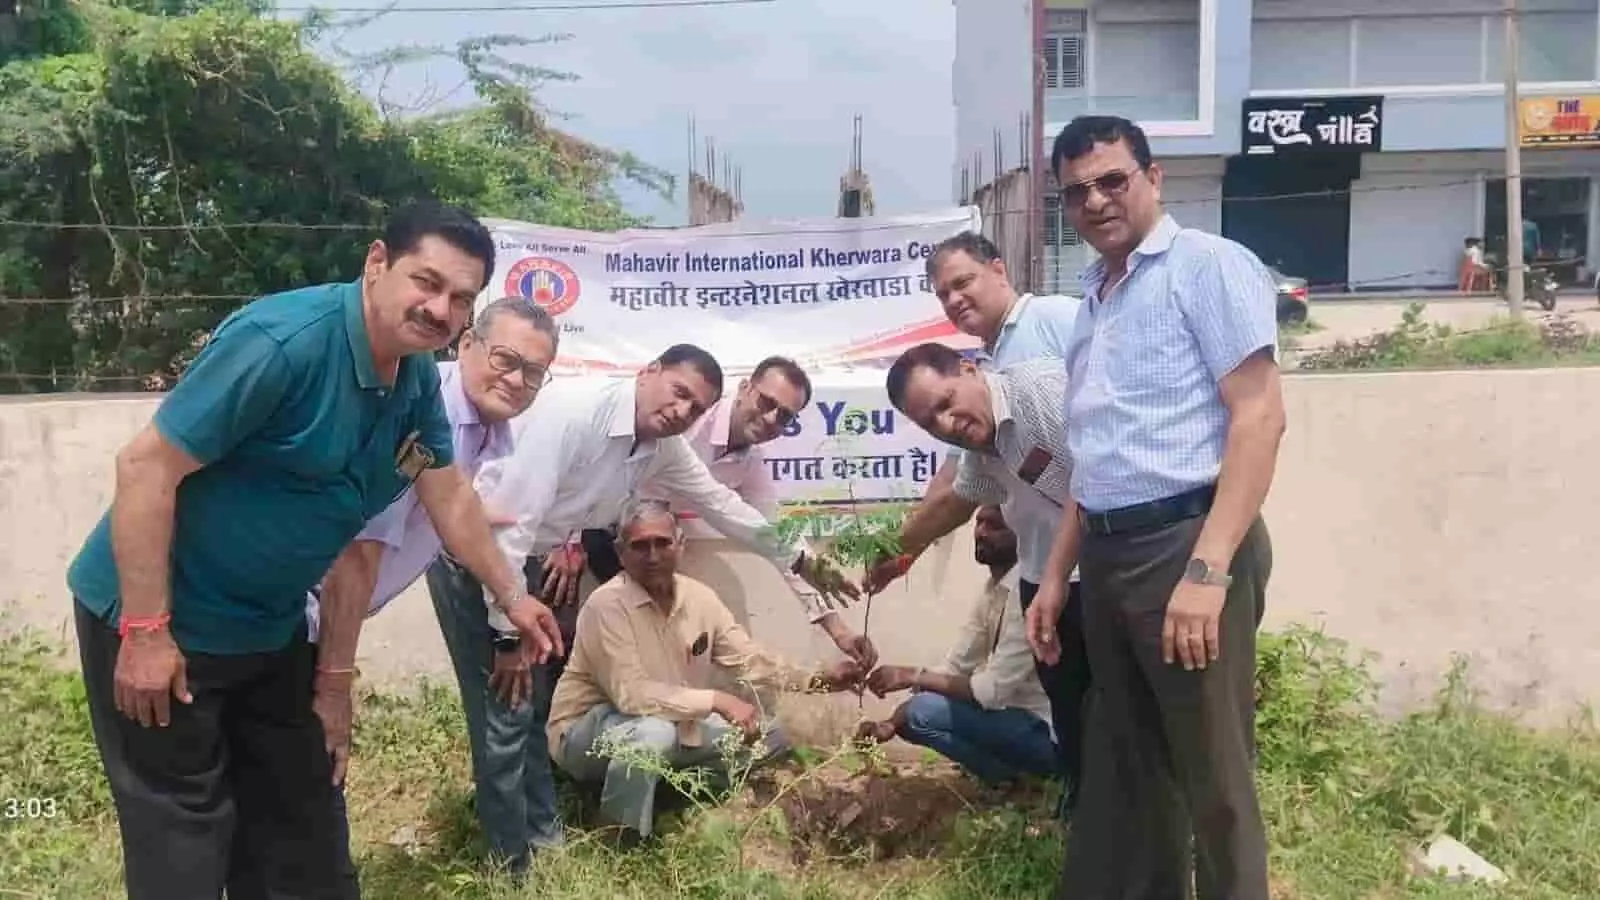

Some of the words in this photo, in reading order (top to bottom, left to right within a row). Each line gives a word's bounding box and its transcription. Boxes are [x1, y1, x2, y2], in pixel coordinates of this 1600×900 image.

[605, 252, 681, 273] Mahavir
[685, 248, 805, 272] International
[811, 246, 901, 268] Kherwara
[609, 281, 691, 311] महावीर
[695, 280, 821, 308] इन्टरनेशनल
[816, 400, 895, 437] You
[832, 454, 905, 480] करता
